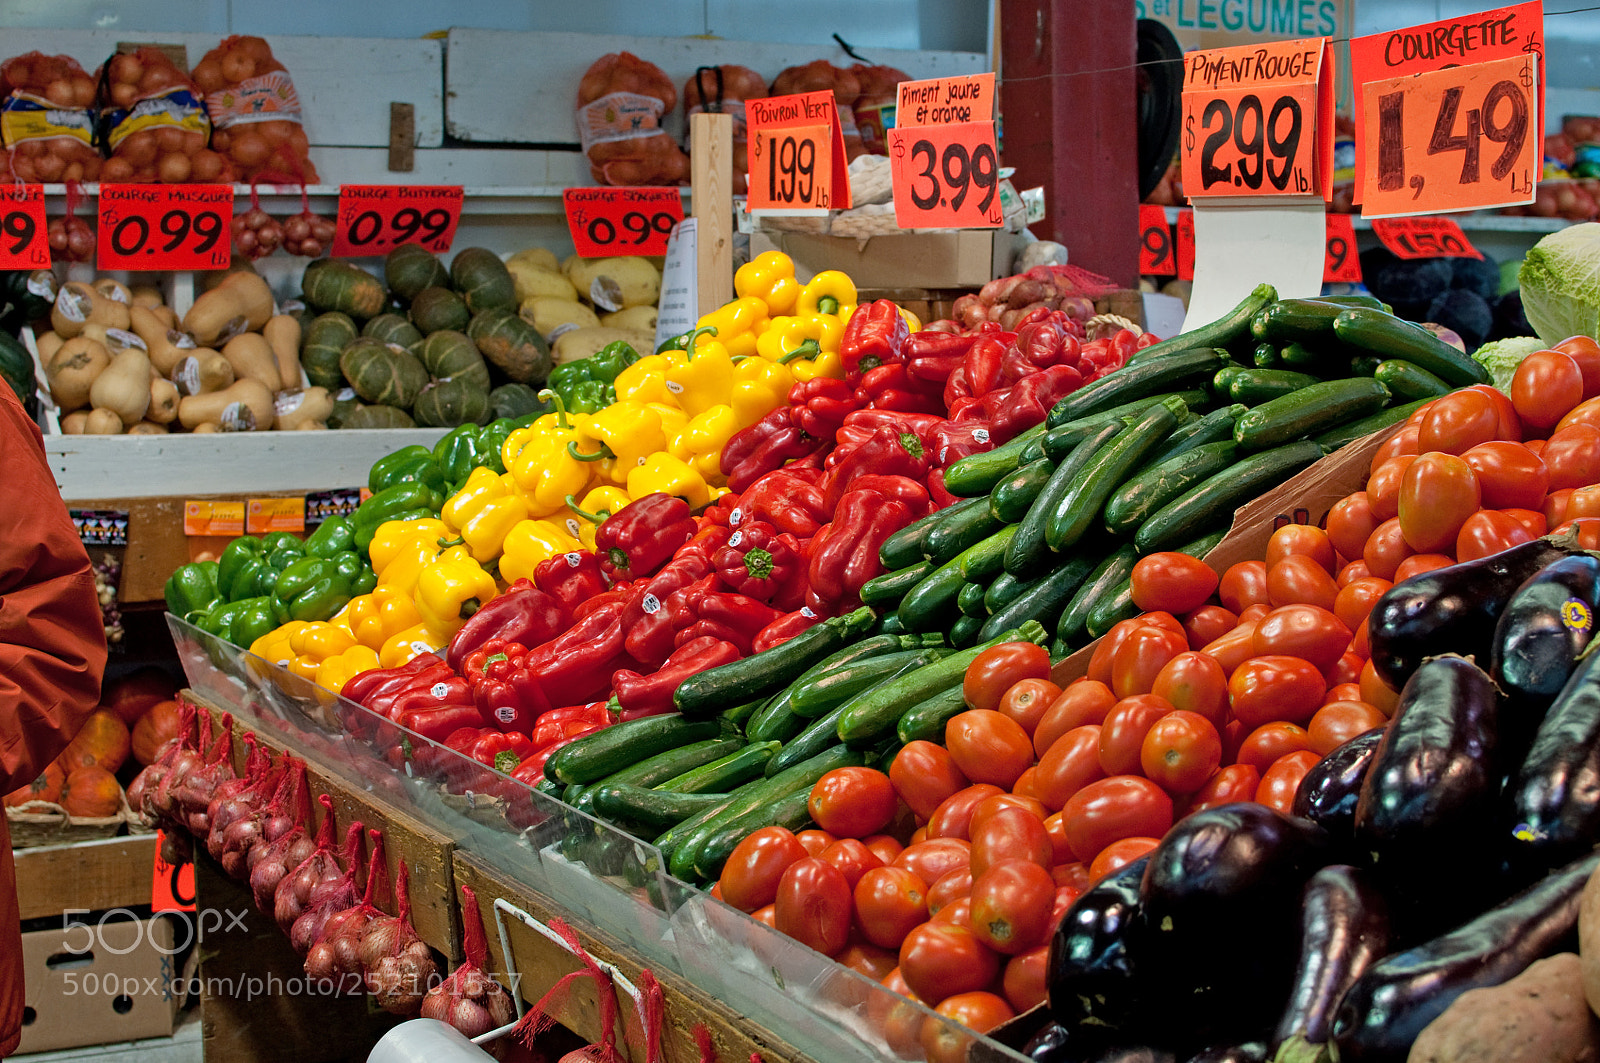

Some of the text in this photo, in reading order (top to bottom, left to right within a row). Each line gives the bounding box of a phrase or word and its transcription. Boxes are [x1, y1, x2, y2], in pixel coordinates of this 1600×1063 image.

[1385, 14, 1517, 66] COURGETTE
[1190, 49, 1316, 89] PIMENT ROUGE
[1519, 59, 1533, 96] $
[801, 96, 829, 118] VERT
[902, 81, 980, 108] Piment jaune
[916, 105, 971, 124] et orange
[1186, 95, 1302, 190] $ 2.99
[769, 136, 815, 203] 1.99
[911, 139, 998, 216] 3.99
[101, 189, 161, 203] COURGE
[340, 186, 392, 199] COURGE
[566, 189, 618, 203] COURGE
[0, 211, 36, 255] 9
[111, 209, 223, 256] 0.99
[348, 208, 450, 246] 0.99
[588, 211, 677, 245] 0.99
